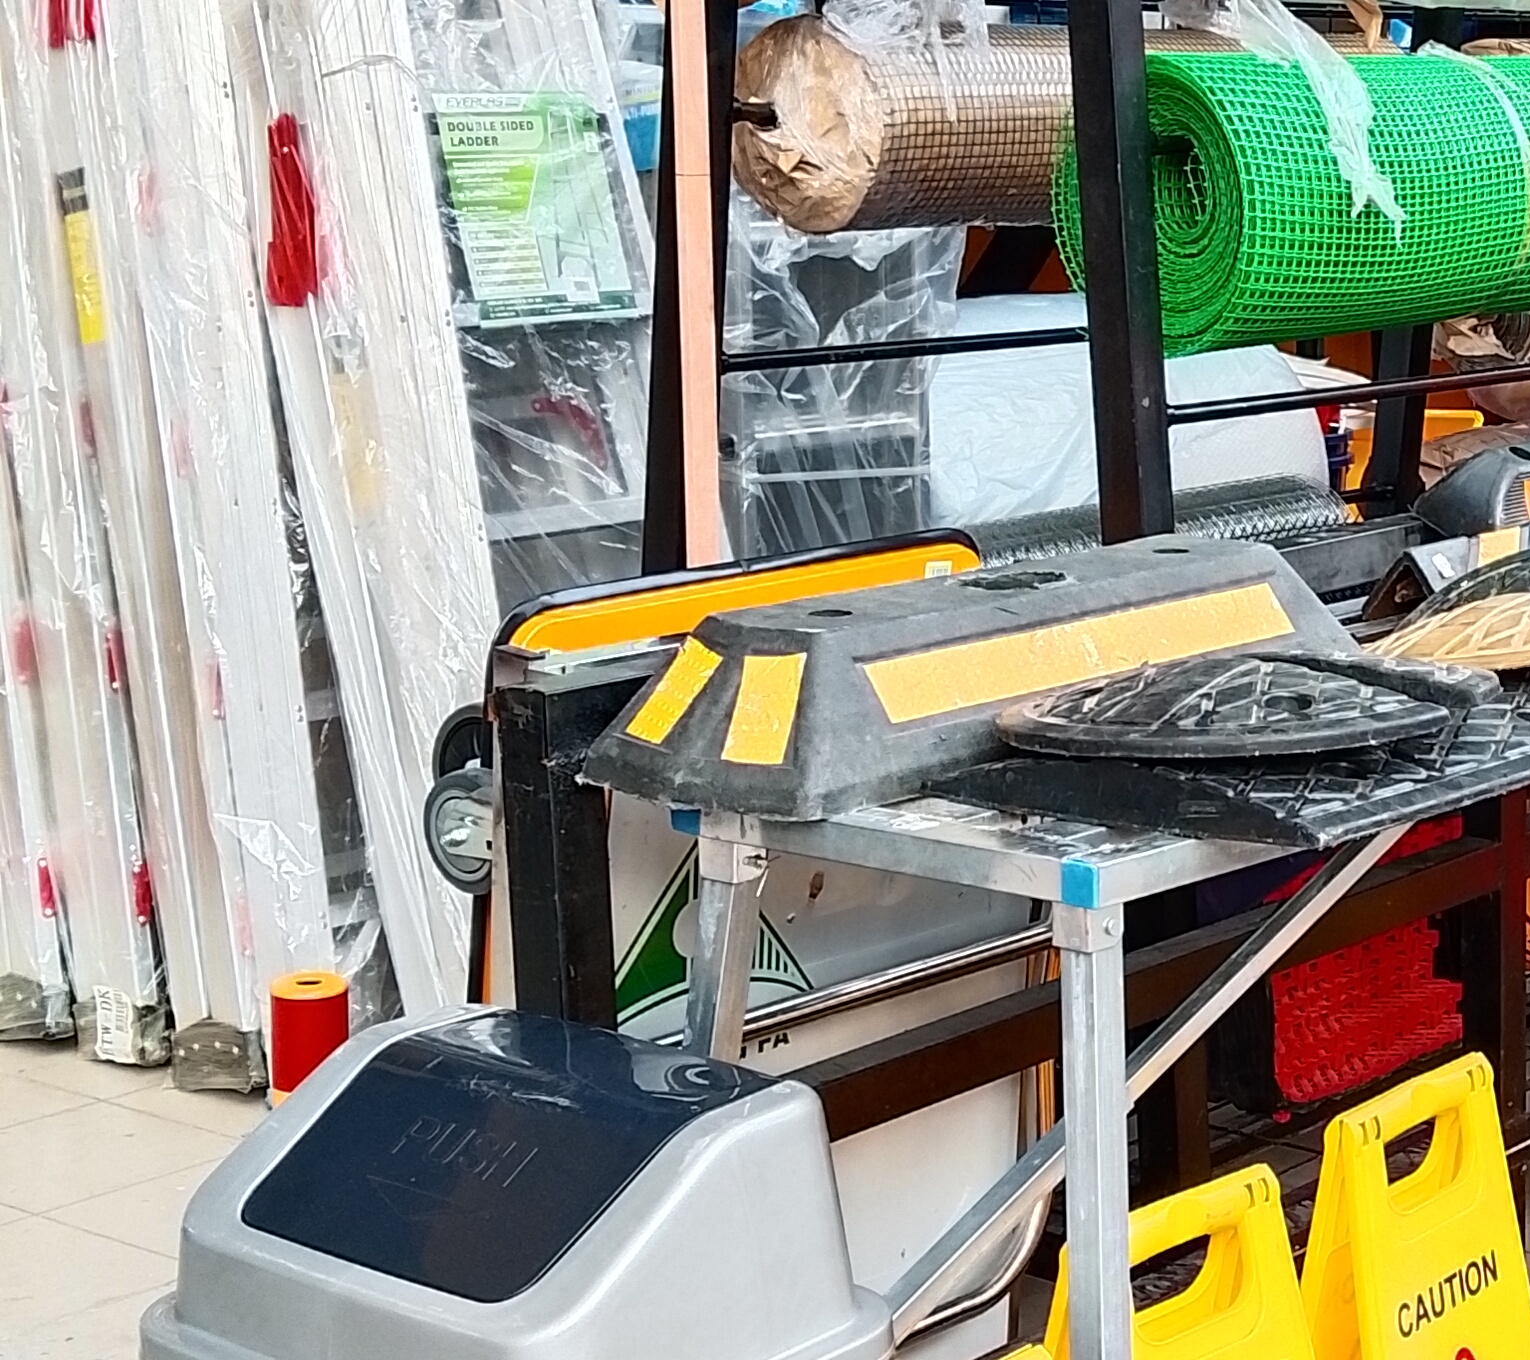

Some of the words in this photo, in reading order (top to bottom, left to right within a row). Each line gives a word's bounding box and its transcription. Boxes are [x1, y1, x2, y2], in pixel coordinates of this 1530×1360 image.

[447, 121, 497, 132] DOUBLE
[500, 120, 534, 131] SIDED
[449, 136, 499, 148] LADDER
[391, 1115, 539, 1187] PUSH
[1397, 1248, 1498, 1338] CAUTION
